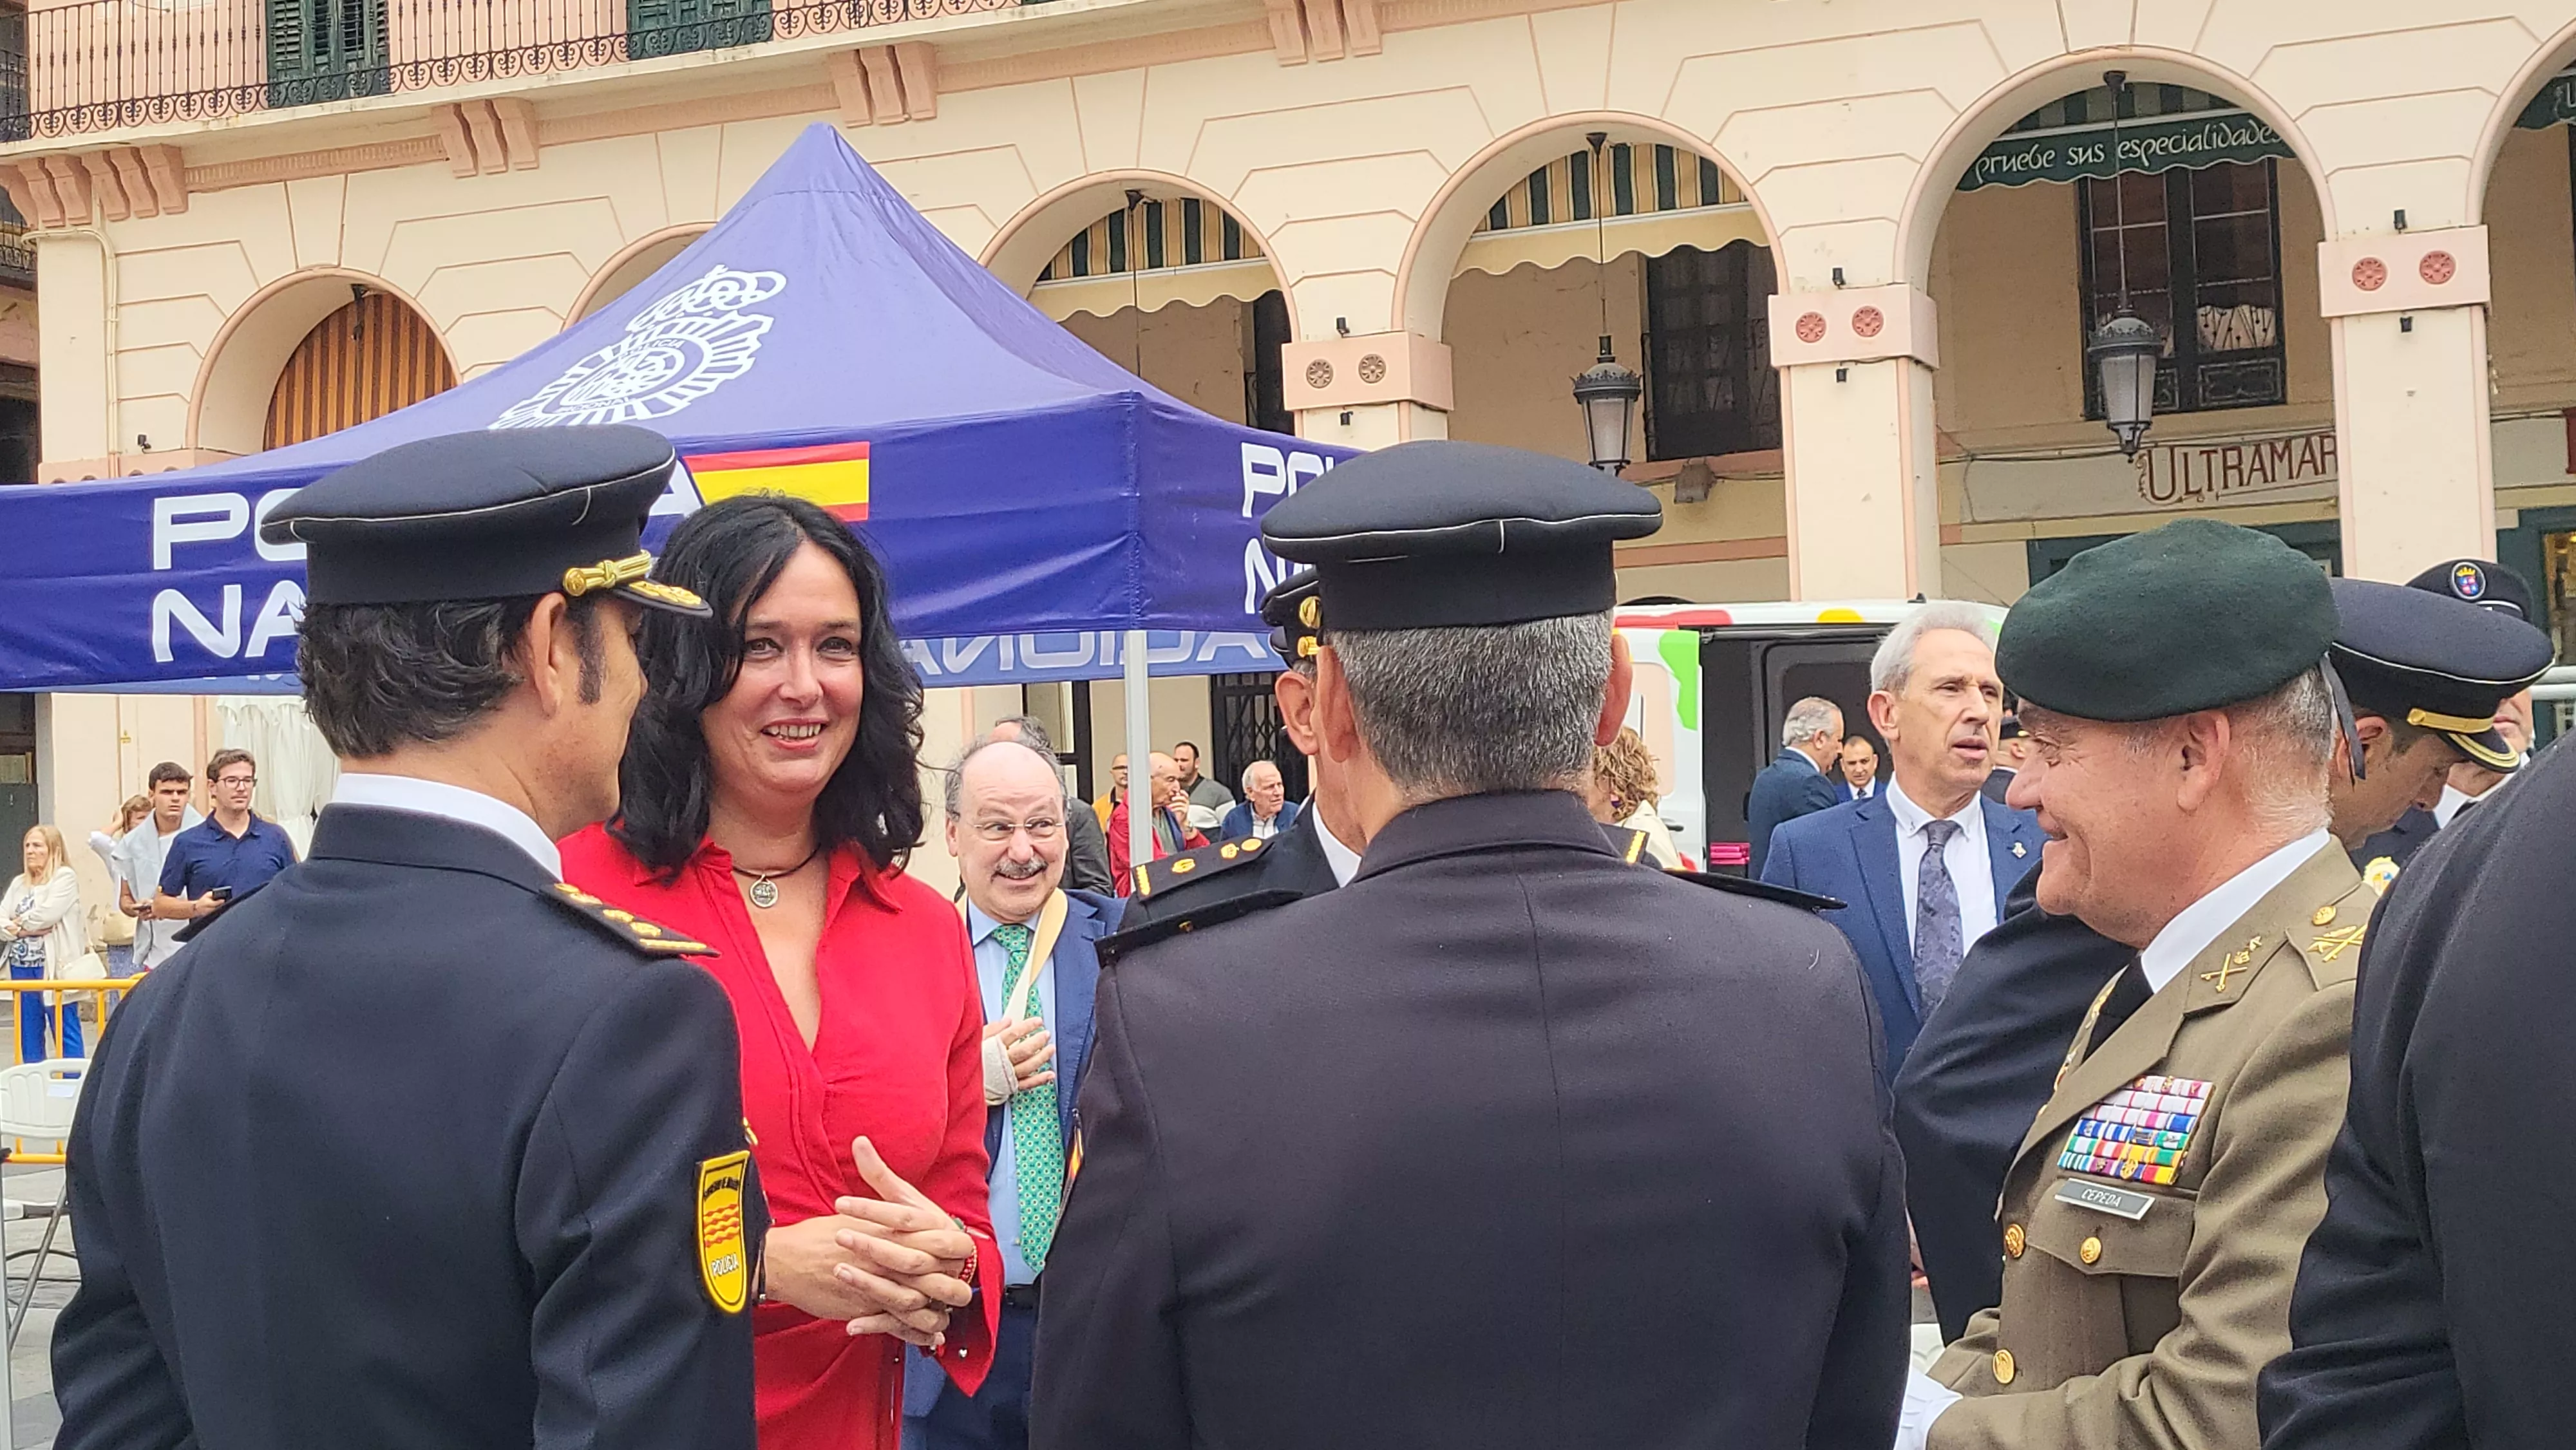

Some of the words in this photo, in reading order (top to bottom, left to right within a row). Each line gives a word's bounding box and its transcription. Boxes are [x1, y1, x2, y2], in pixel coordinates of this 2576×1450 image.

[1975, 144, 2056, 184] pruebe
[2066, 143, 2105, 166] sus
[2117, 119, 2282, 167] especialidades
[2081, 1188, 2123, 1207] CEPEDA
